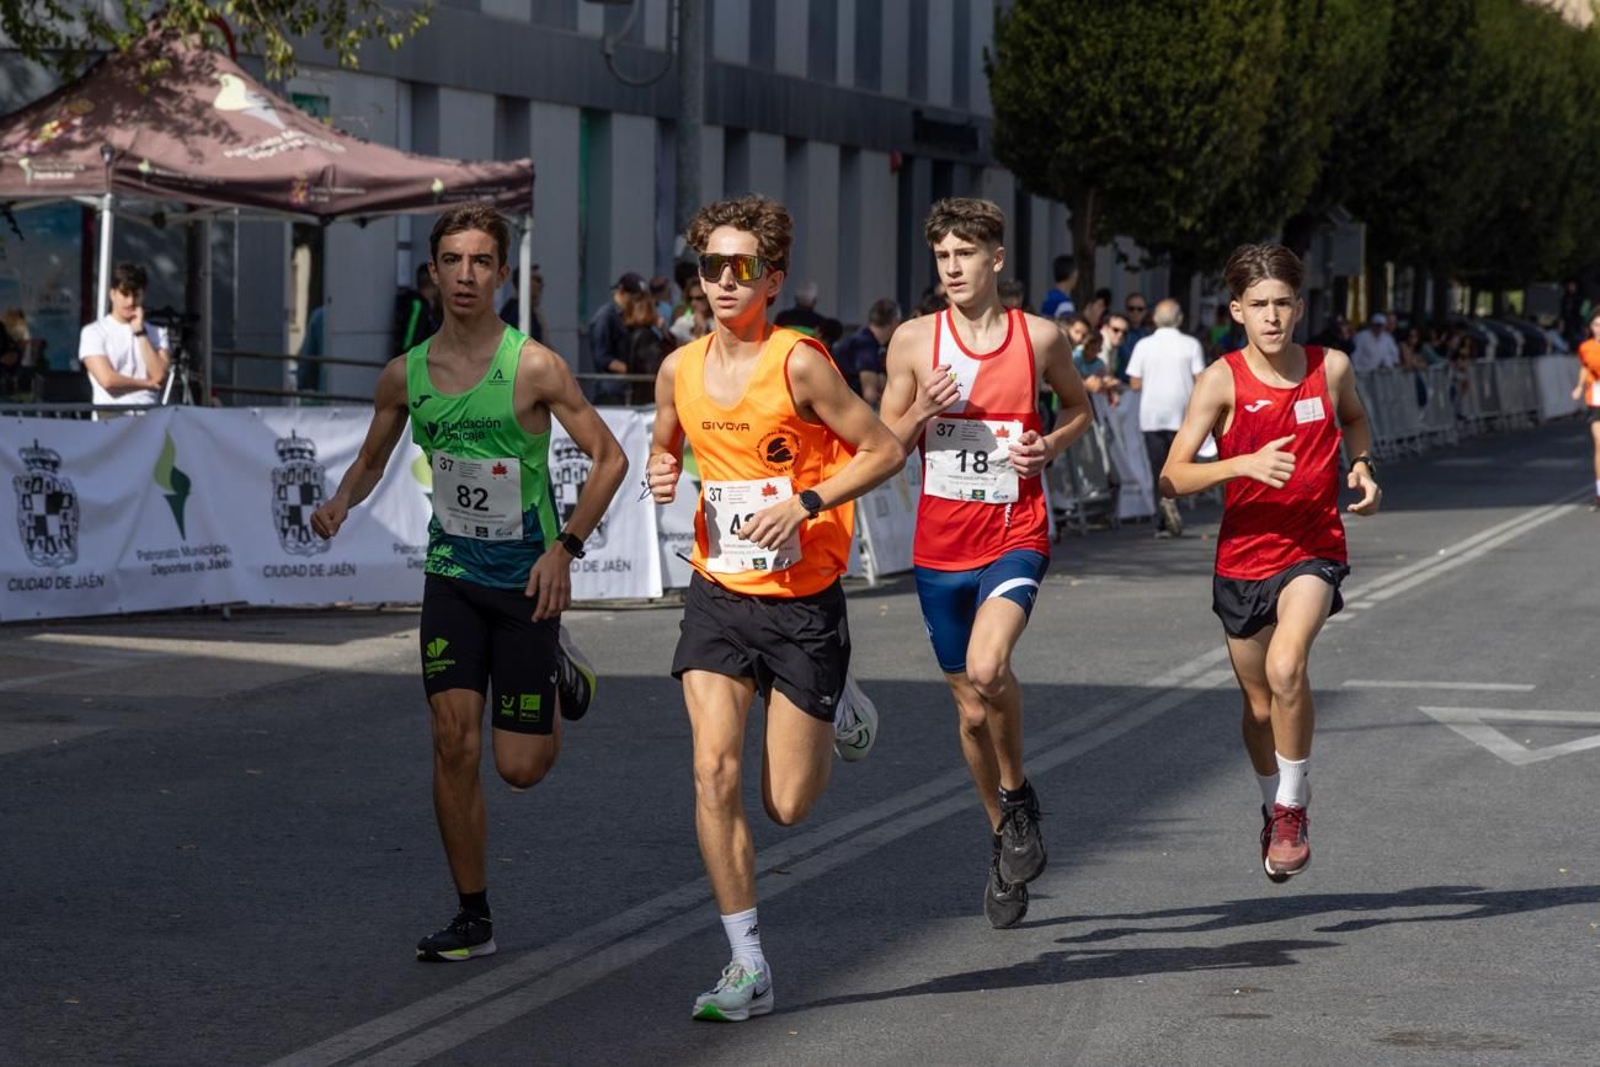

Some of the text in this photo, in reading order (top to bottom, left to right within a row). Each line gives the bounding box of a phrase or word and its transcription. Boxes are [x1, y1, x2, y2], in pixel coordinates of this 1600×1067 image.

[701, 422, 750, 432] GIVOVA
[936, 422, 956, 438] 37
[439, 456, 454, 472] 37
[955, 448, 989, 474] 18
[456, 484, 489, 512] 82
[708, 487, 722, 502] 37
[729, 513, 756, 535] 4
[181, 545, 232, 558] Municipa
[151, 563, 192, 577] Deportes
[194, 561, 206, 572] de
[263, 560, 356, 578] CIUDAD DE JAÉN
[583, 560, 599, 573] DE
[601, 556, 632, 572] JAÉN
[7, 571, 106, 592] CIUDAD DE JAÉN
